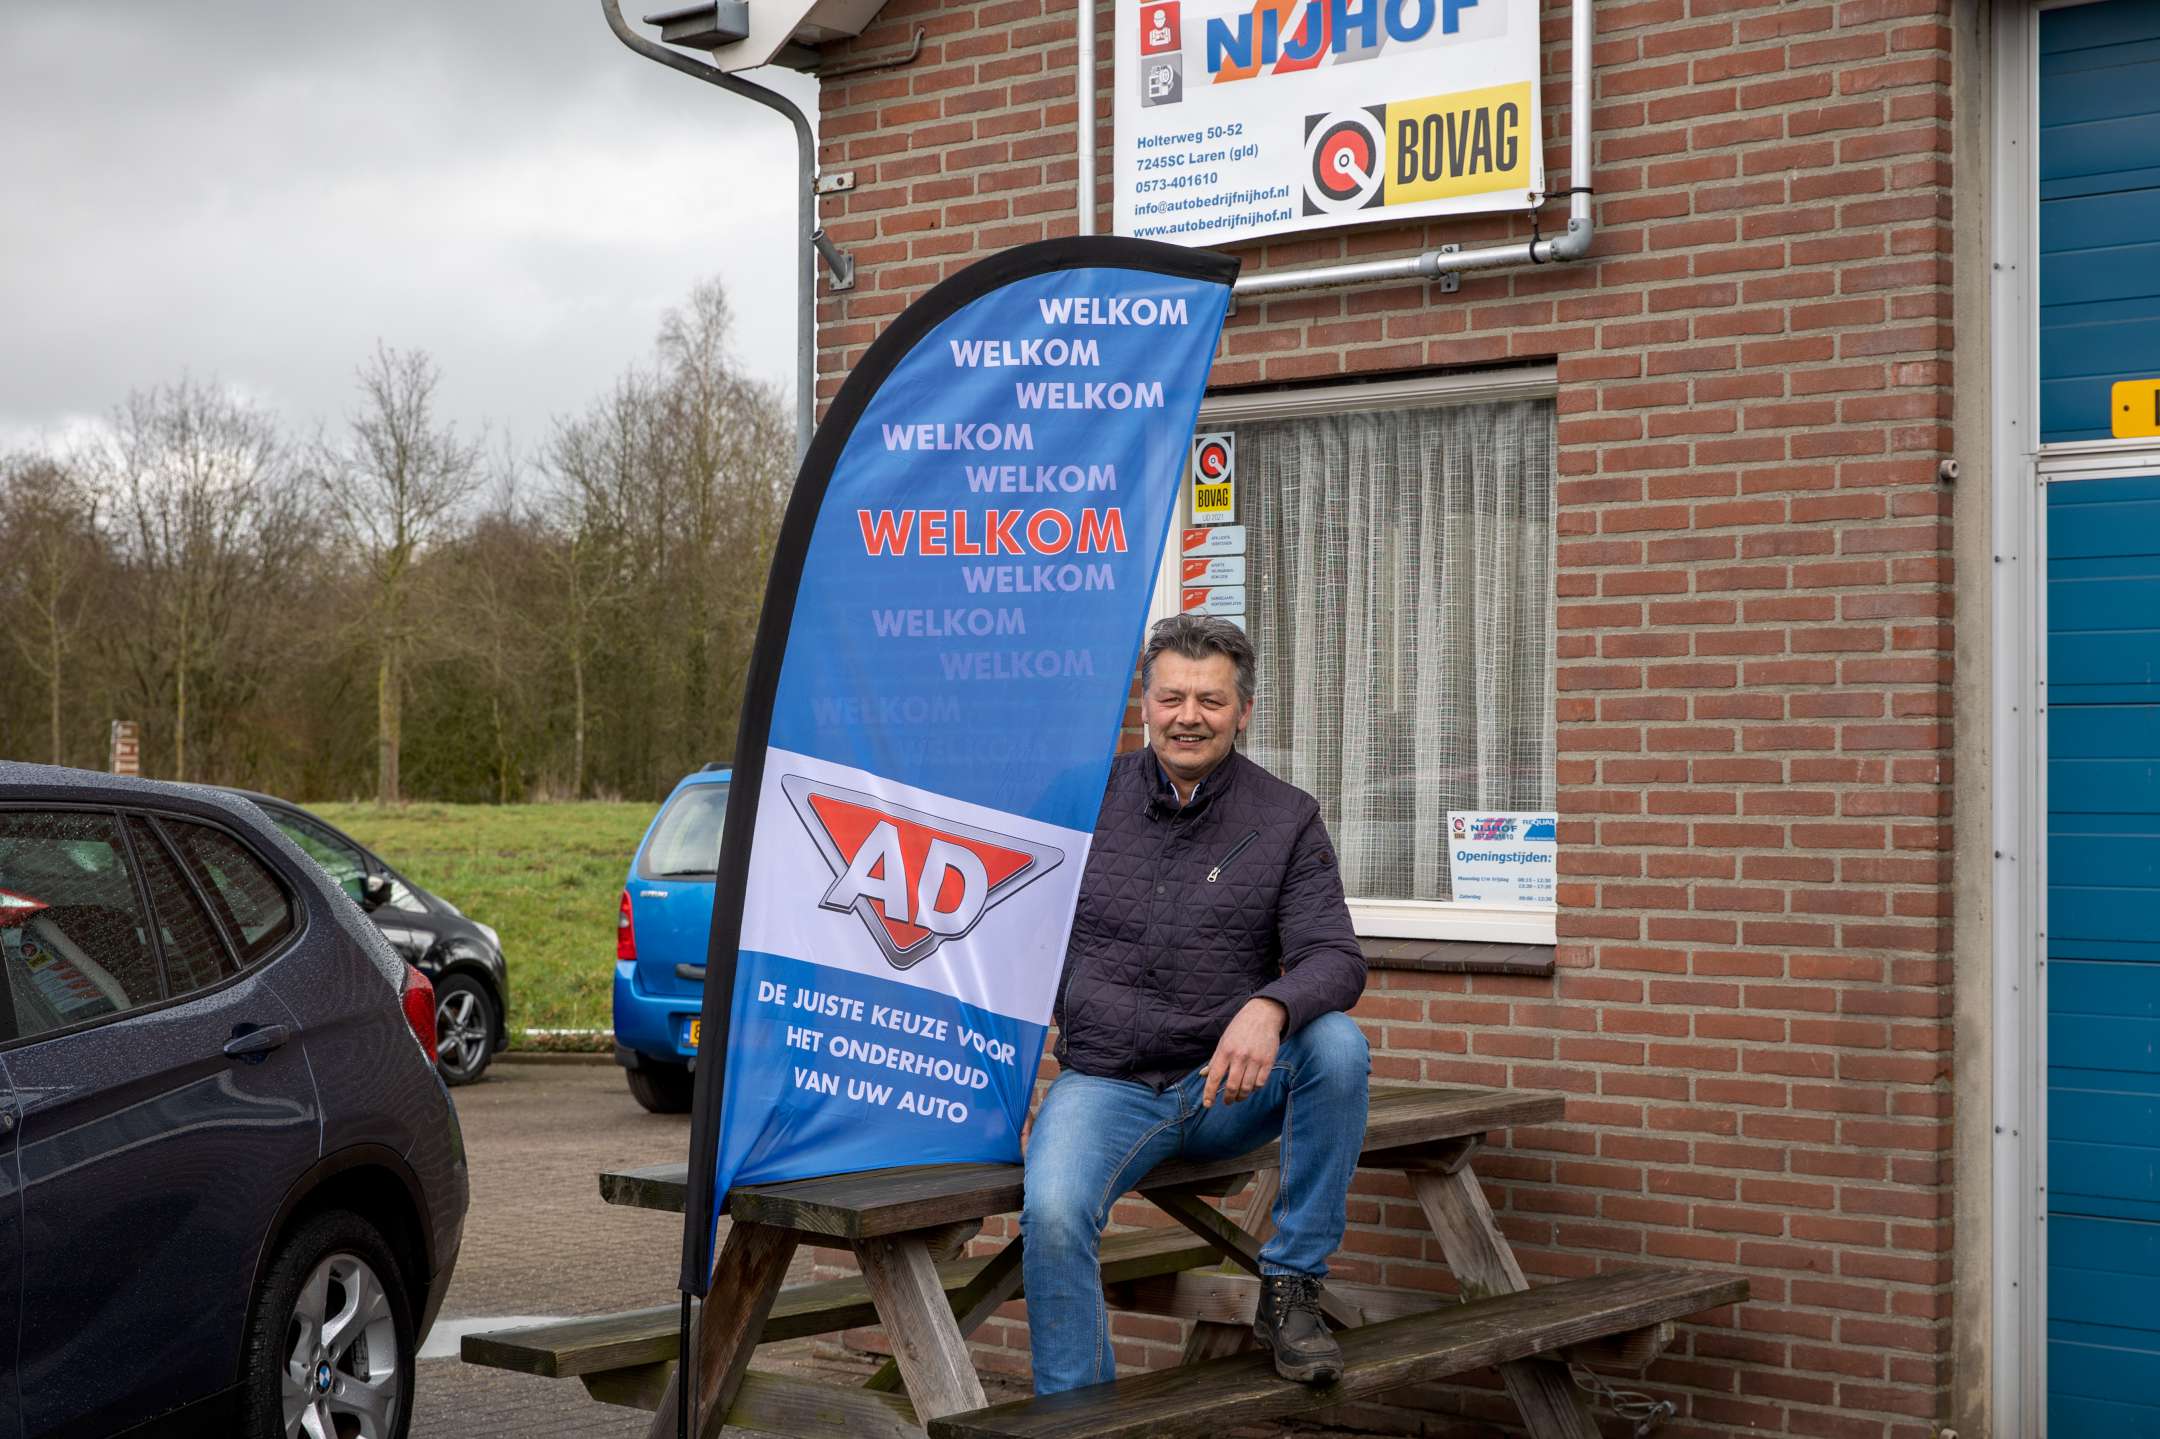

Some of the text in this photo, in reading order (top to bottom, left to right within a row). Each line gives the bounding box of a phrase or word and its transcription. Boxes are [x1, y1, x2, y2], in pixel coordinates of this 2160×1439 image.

[1207, 0, 1478, 74] NIJHOF
[1137, 123, 1243, 149] Holterweg 50-52
[1397, 102, 1519, 185] BOVAG
[1137, 144, 1259, 171] 7245SC Laren (gld)
[1135, 172, 1218, 193] 0573-401610
[1134, 185, 1290, 216] info@autobedrijfnijhof.nl
[1133, 208, 1293, 238] www.autobedrijfnijhof.nl
[1039, 297, 1189, 326] WELKOM
[950, 339, 1100, 368] WELKOM
[1015, 381, 1165, 410] WELKOM
[881, 423, 1034, 451] WELKOM
[965, 464, 1118, 493] WELKOM
[1198, 488, 1228, 508] BOVAG
[857, 507, 1128, 556] WELKOM
[962, 563, 1116, 593] WELKOM
[871, 607, 1027, 638] WELKOM
[939, 649, 1095, 681] WELKOM
[811, 695, 962, 726] WELKOM
[1471, 824, 1518, 833] NIJHOF
[1456, 851, 1552, 864] Openingstijden:
[823, 818, 990, 937] AD
[757, 980, 1016, 1066] DE JUISTE KEUZE VOOR
[786, 1025, 989, 1090] HET ONDERHOUD
[794, 1066, 969, 1124] VAN UW AUTO
